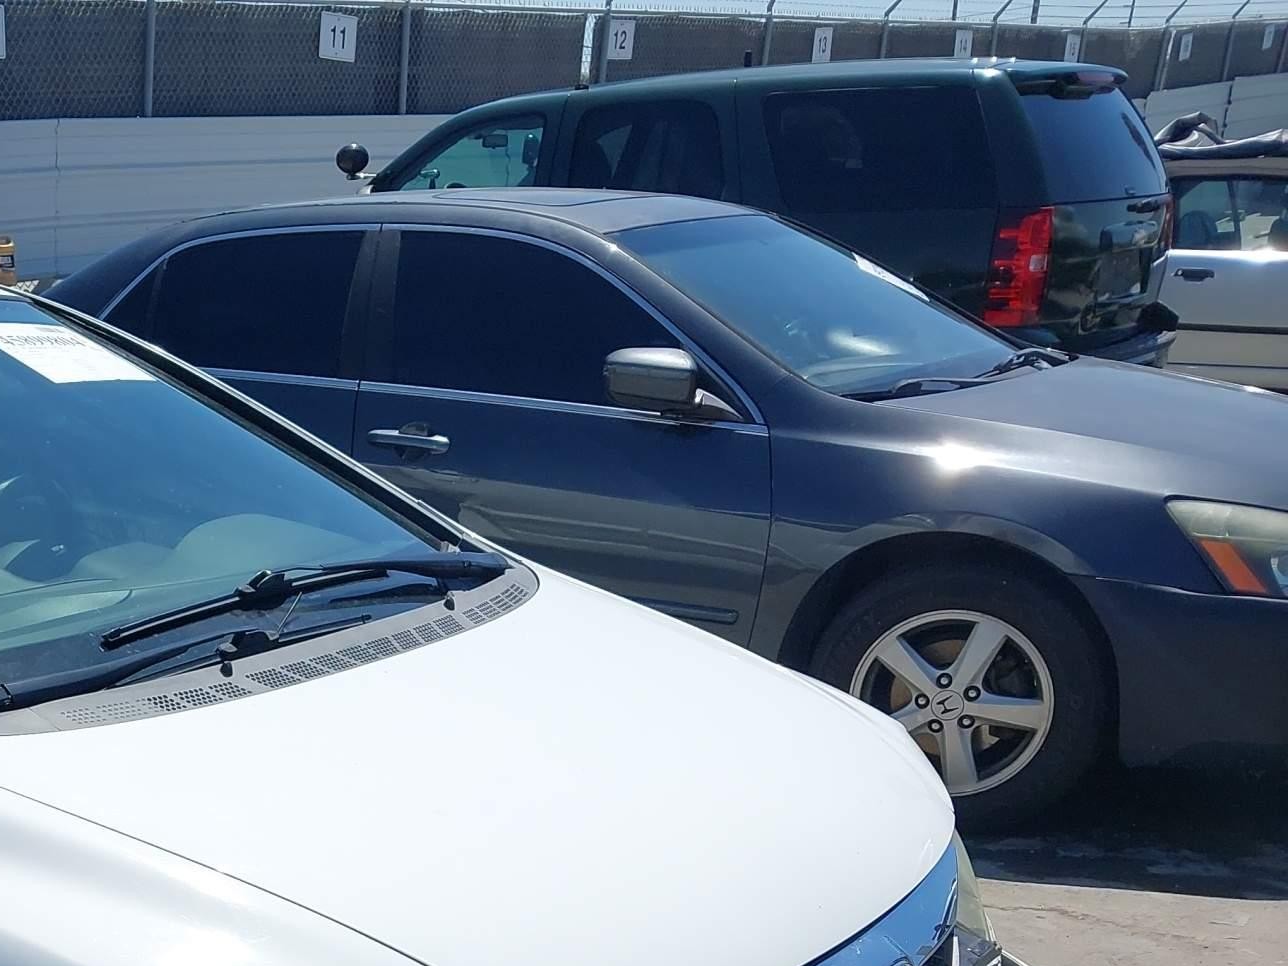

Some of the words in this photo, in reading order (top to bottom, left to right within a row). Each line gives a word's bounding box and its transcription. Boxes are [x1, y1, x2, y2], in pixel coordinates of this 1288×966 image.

[330, 25, 346, 49] 11
[614, 29, 627, 50] 12
[818, 36, 828, 54] 13
